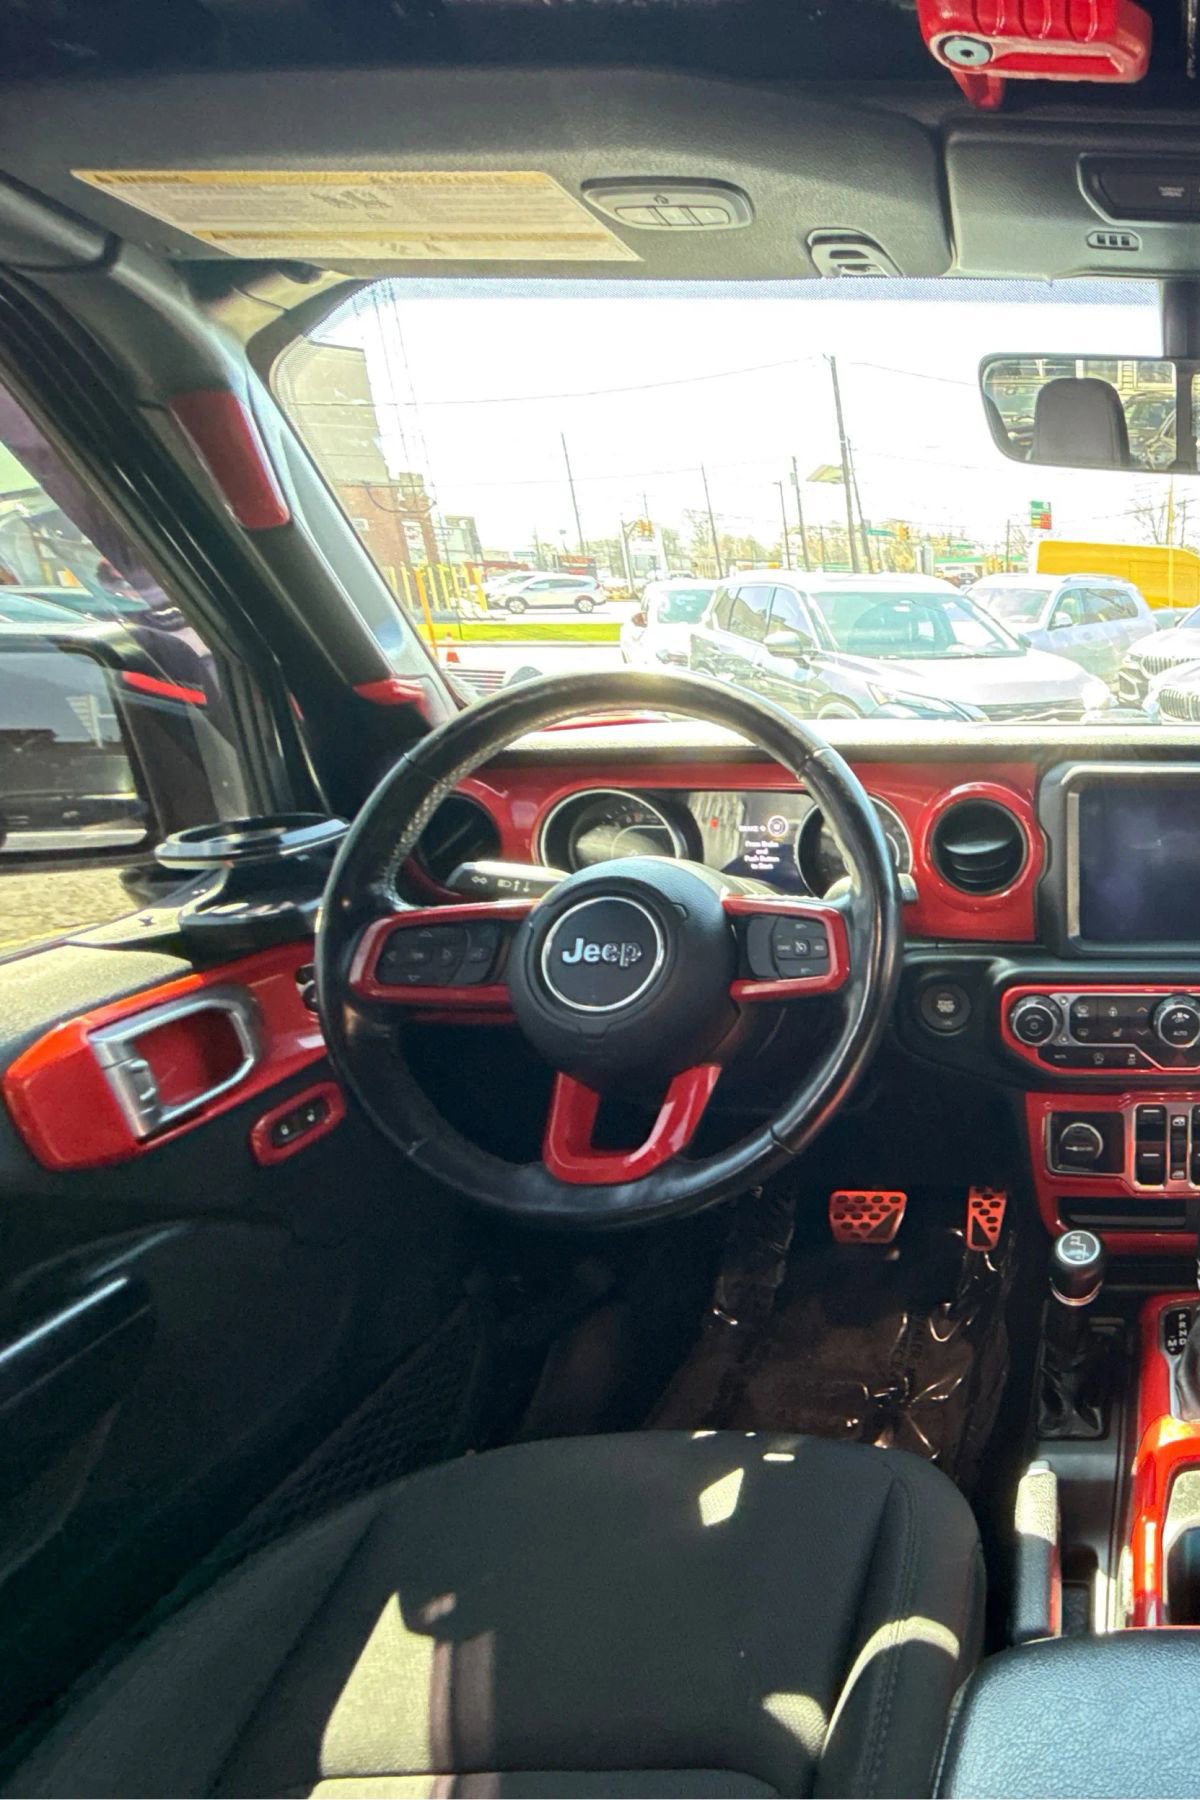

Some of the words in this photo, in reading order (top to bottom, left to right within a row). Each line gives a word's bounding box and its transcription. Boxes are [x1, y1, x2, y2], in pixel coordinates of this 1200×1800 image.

[562, 937, 642, 967] Jeep
[1179, 1329, 1187, 1337] N
[1167, 1339, 1178, 1347] M
